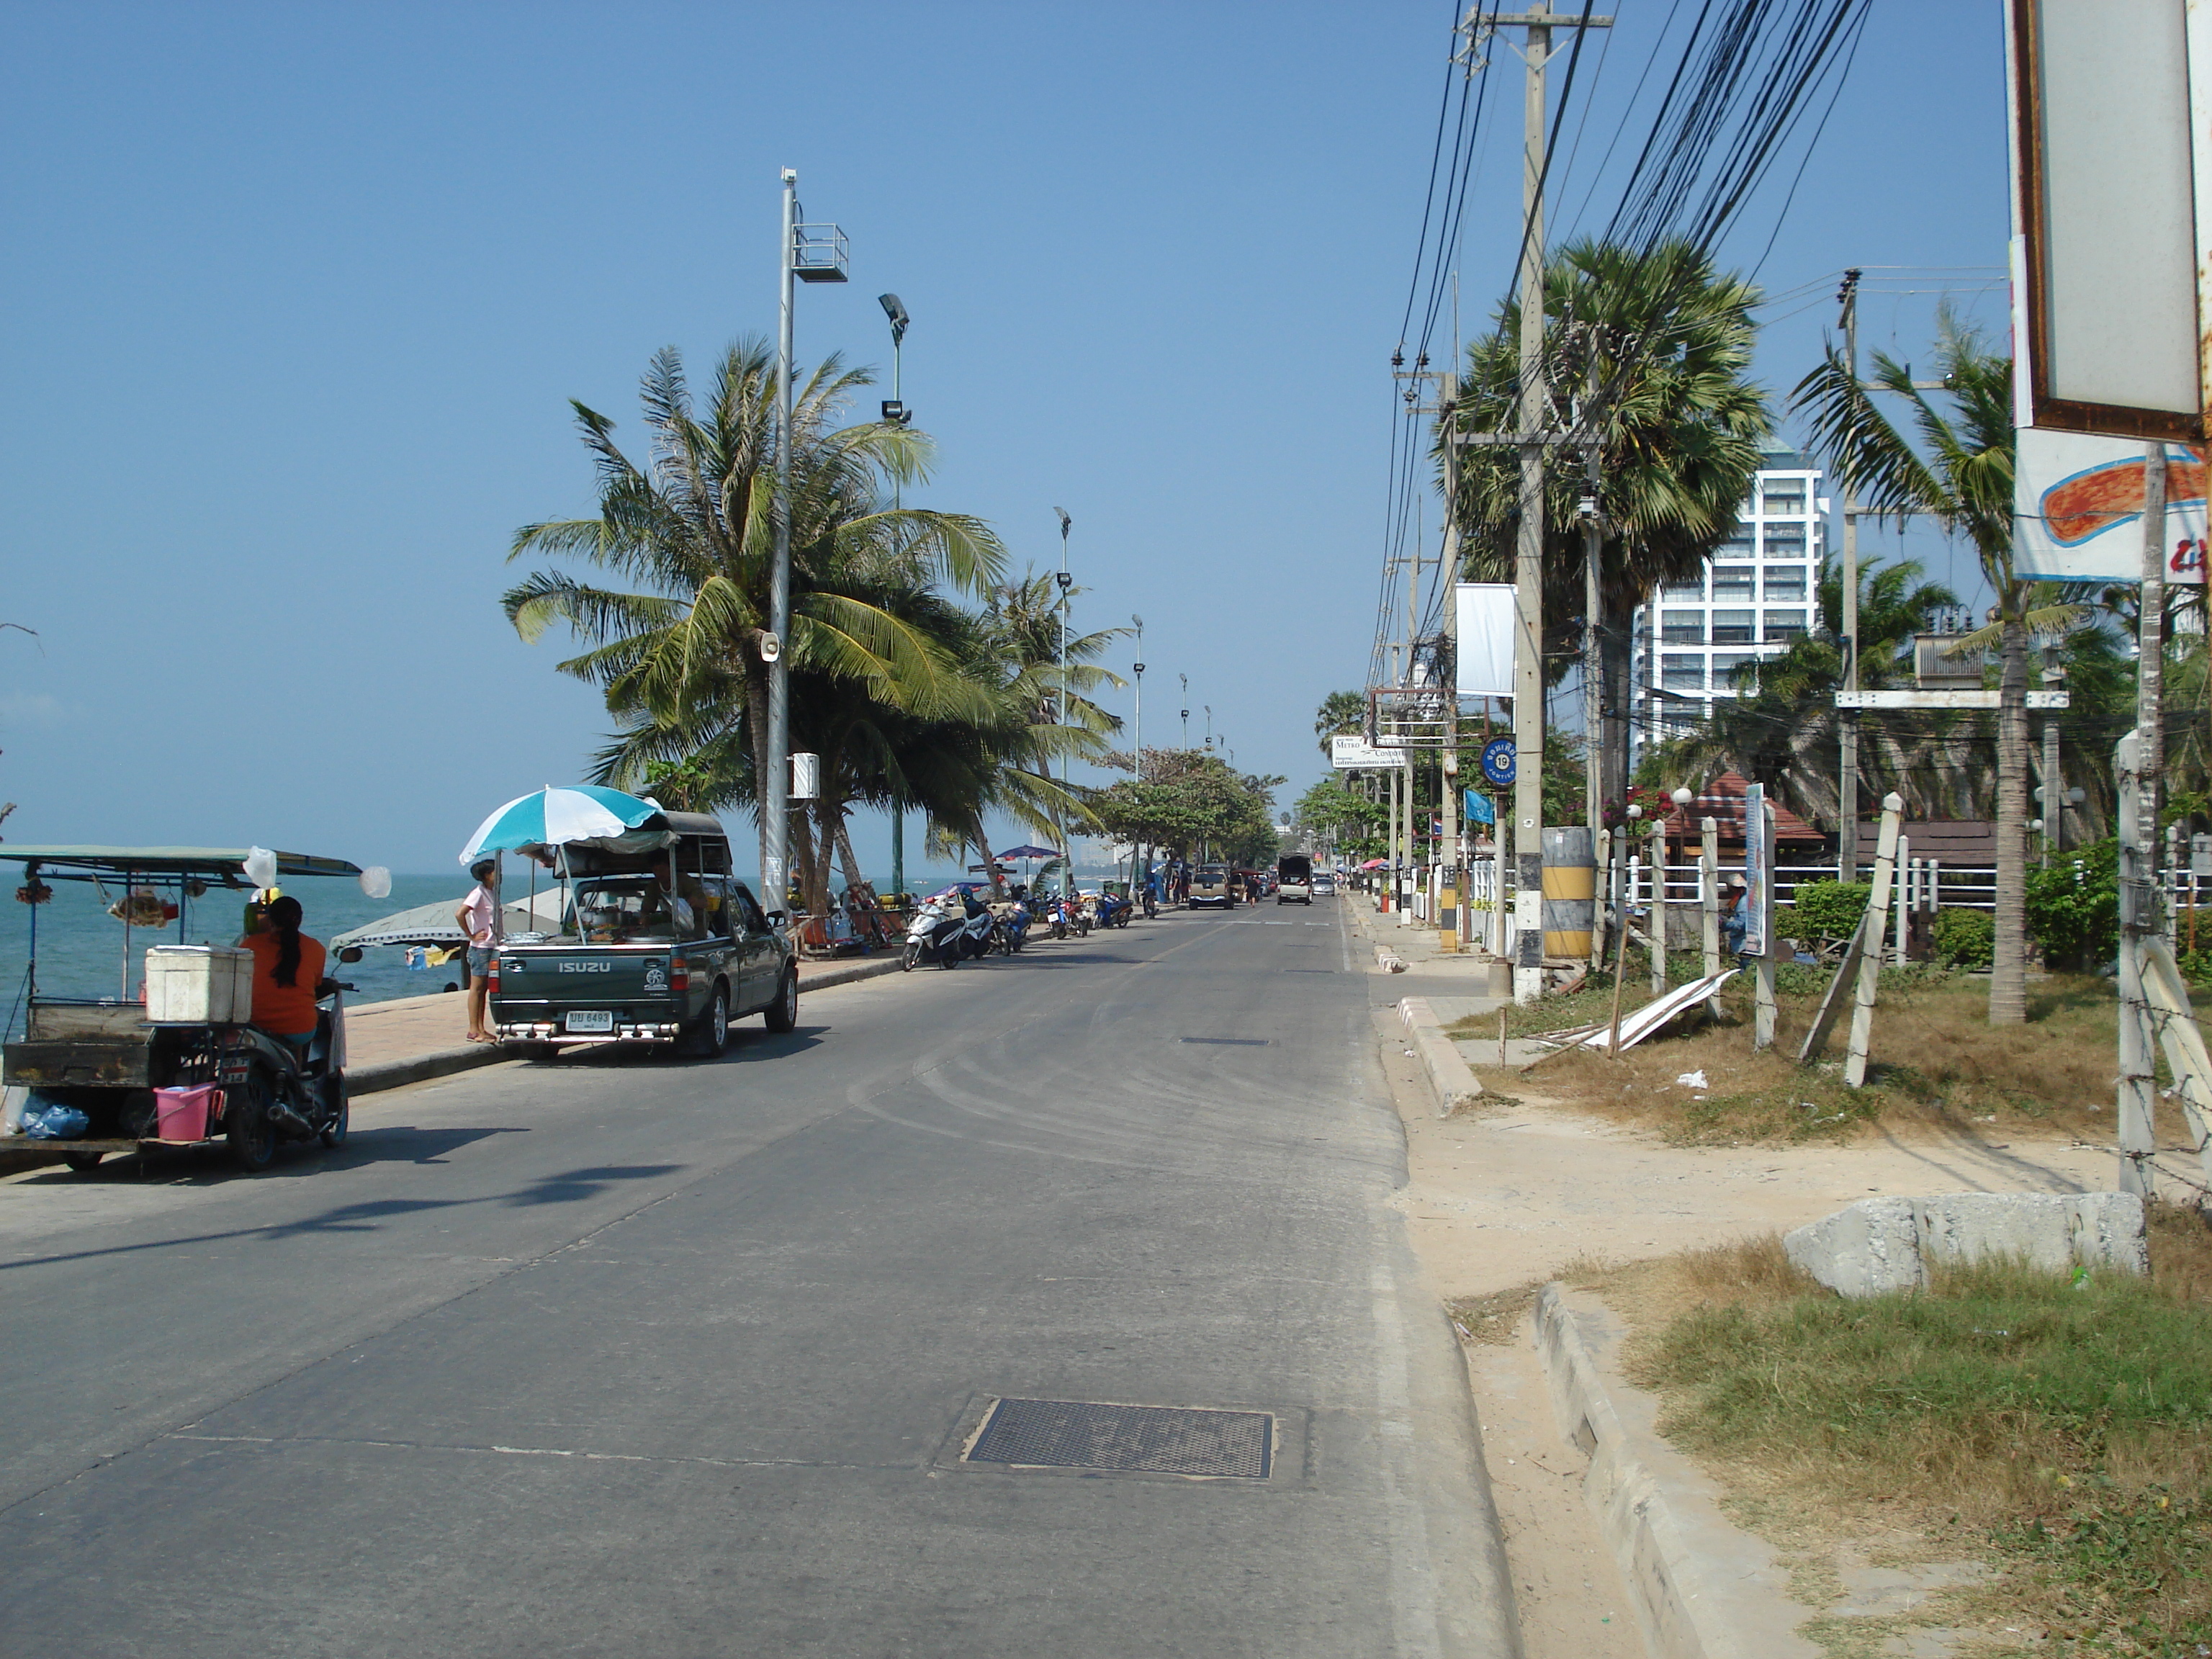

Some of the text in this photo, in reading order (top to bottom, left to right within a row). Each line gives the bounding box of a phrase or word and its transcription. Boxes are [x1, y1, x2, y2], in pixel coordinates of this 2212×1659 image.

[1498, 757, 1507, 766] 19
[1489, 768, 1515, 779] JOMTIEN
[559, 962, 611, 973] ISUZU
[587, 1013, 608, 1022] 6493
